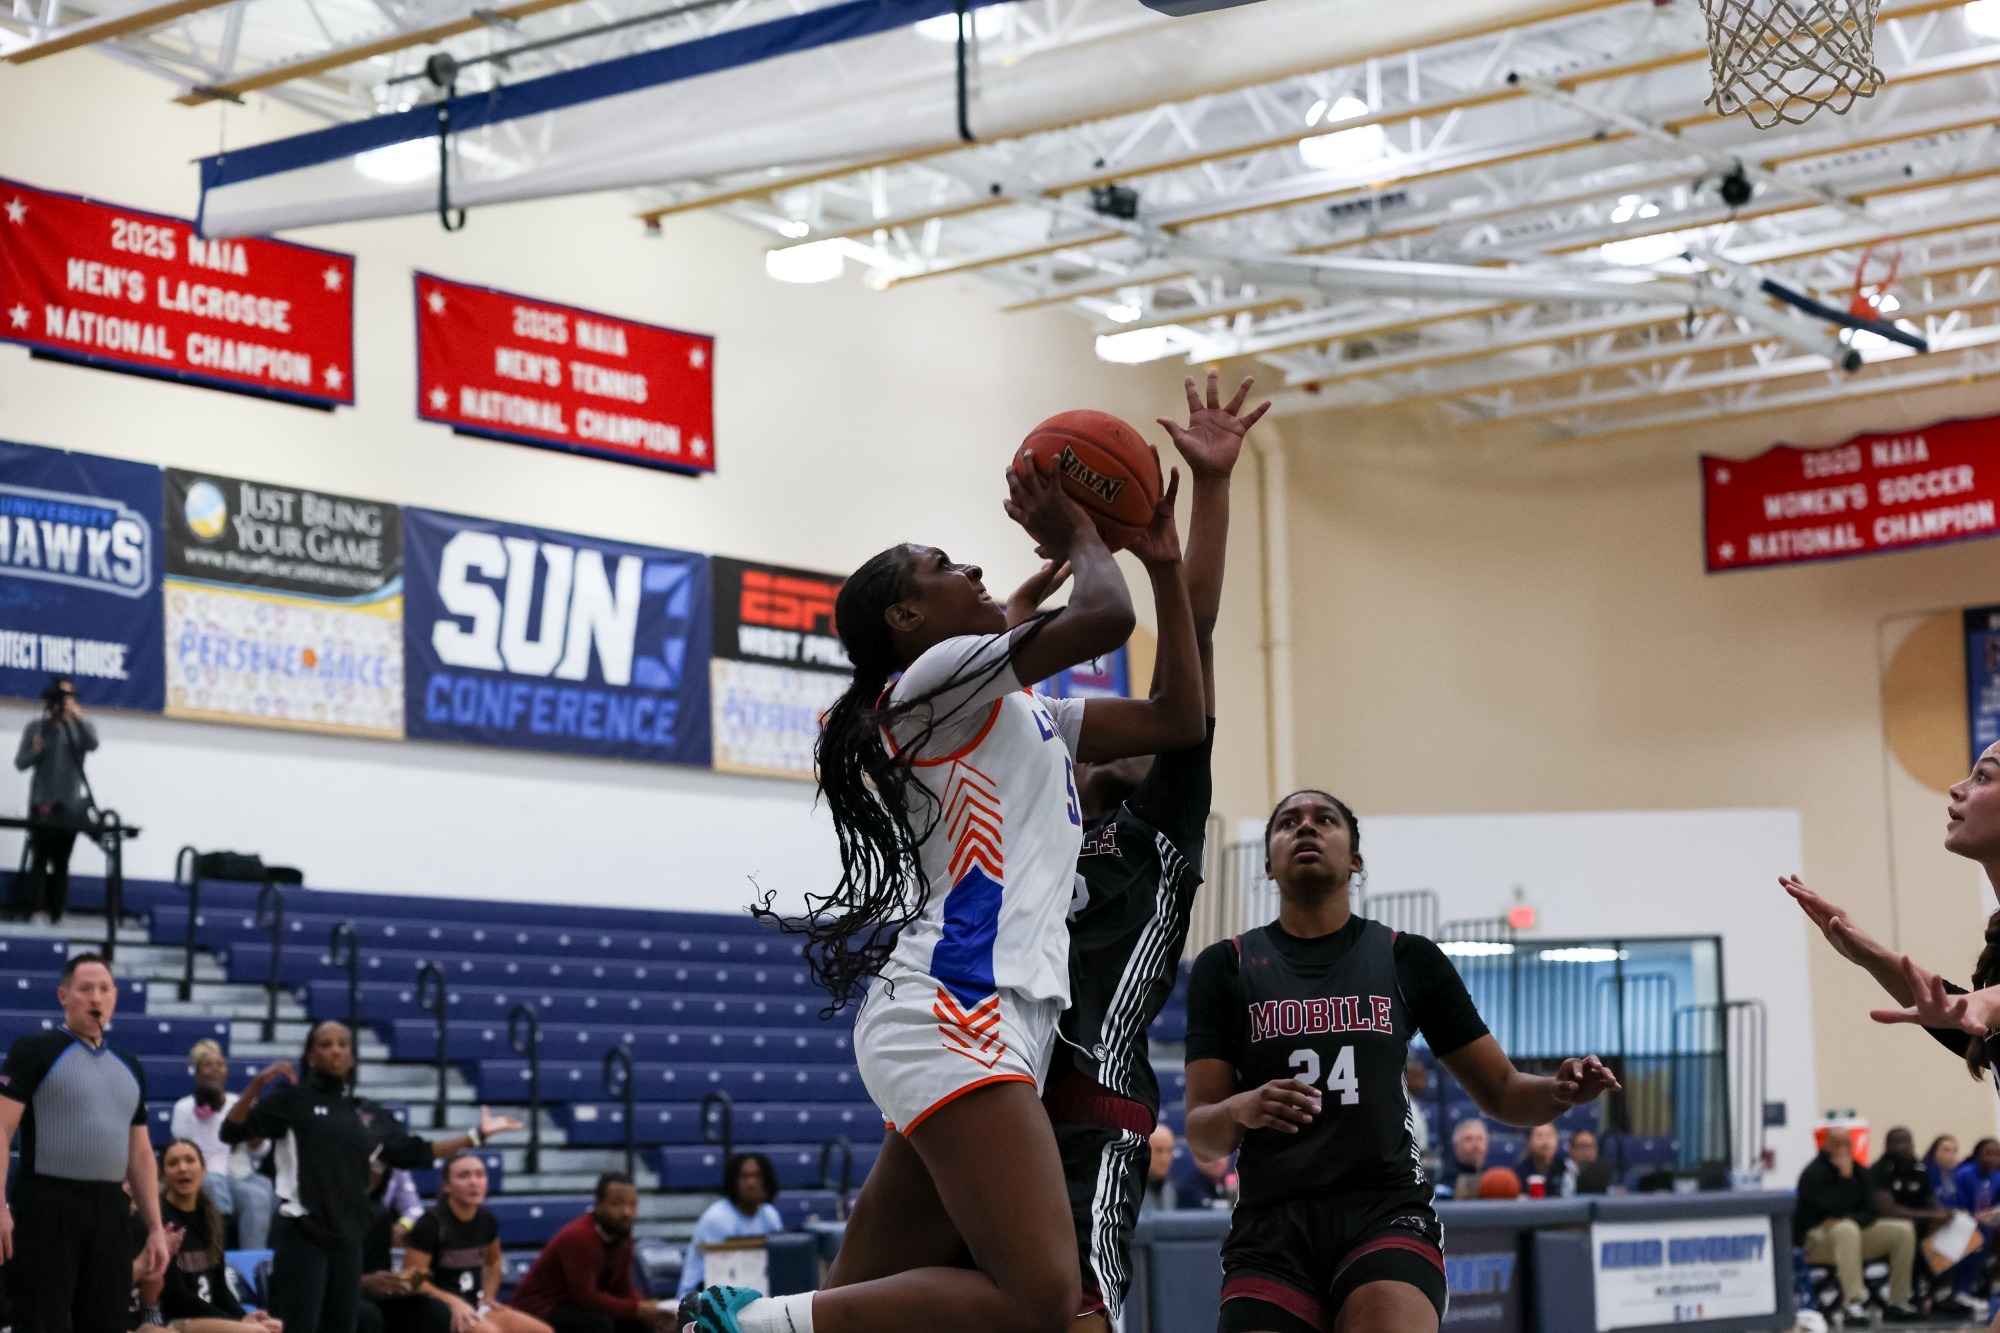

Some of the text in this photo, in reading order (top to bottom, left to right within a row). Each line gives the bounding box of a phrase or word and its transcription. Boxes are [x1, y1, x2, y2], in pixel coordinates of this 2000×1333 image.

[111, 218, 248, 277] 2025 NAIA
[67, 257, 292, 333] MEN'S LACROSSE
[46, 304, 312, 386] NATIONAL CHAMPION
[512, 305, 628, 357] 2025 NAIA
[495, 346, 648, 405] MEN'S TENNIS
[459, 385, 681, 455] NATIONAL CHAMPION
[1060, 444, 1125, 504] NAIA
[1870, 435, 1930, 468] NAIA
[240, 481, 383, 537] JUST BRING
[1763, 464, 1975, 521] WOMEN'S SOCCER
[232, 513, 306, 560] YOUR
[306, 525, 384, 570] GAME
[1748, 500, 1996, 559] NATIONAL CHAMPION
[432, 529, 644, 687] SUN
[740, 570, 842, 638] ESP
[40, 633, 74, 675] THIS
[738, 623, 800, 661] WEST
[425, 671, 681, 748] CONFERENCE
[1063, 755, 1082, 827] 5
[1249, 995, 1393, 1043] MOBILE
[1287, 1045, 1360, 1111] 24
